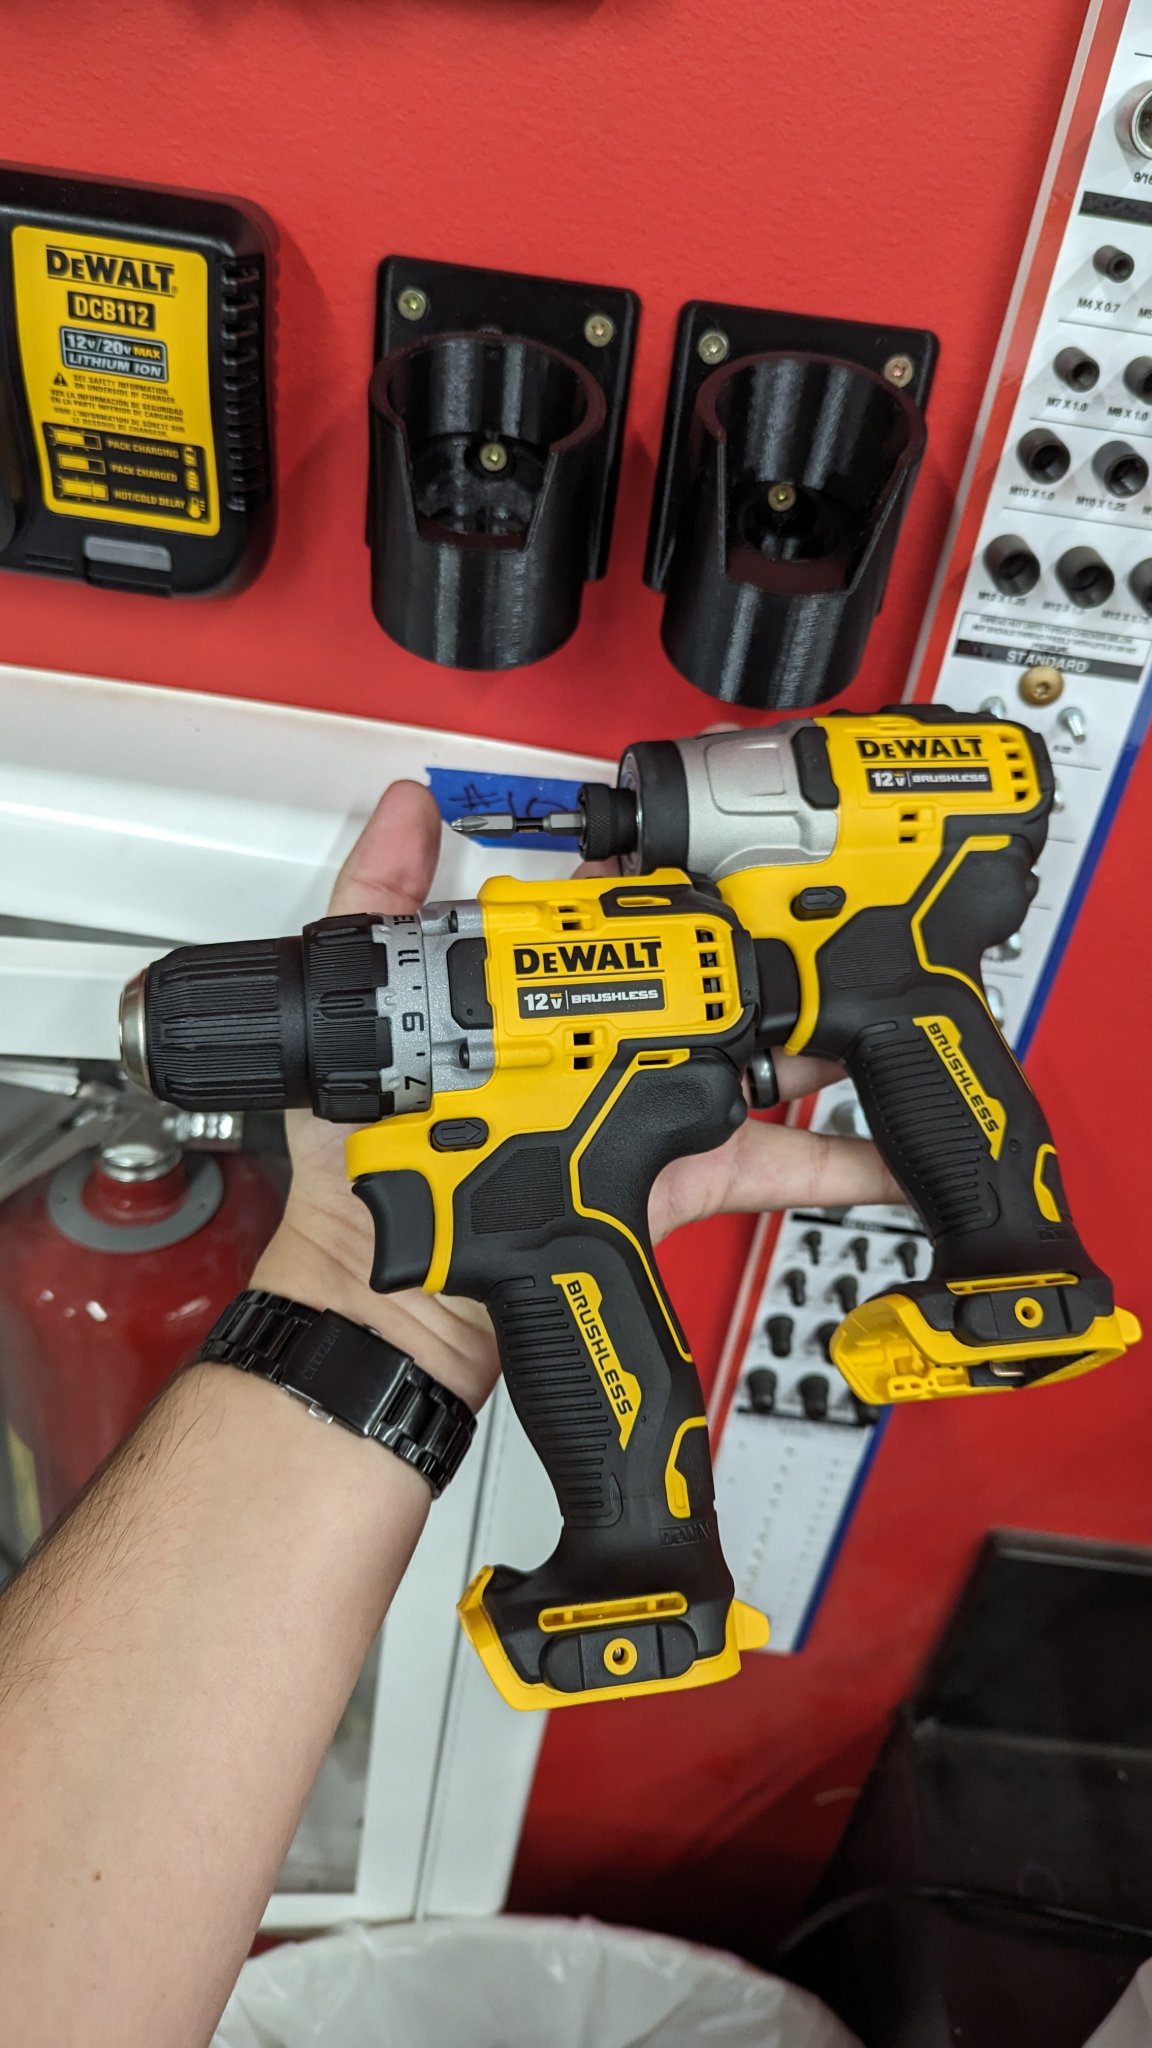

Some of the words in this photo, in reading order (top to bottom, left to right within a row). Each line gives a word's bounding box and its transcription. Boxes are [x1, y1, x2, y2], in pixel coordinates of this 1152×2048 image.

[74, 295, 149, 327] DCB112
[1077, 298, 1093, 309] M4
[1094, 301, 1103, 311] X
[1104, 302, 1121, 314] 0.7
[133, 347, 161, 359] MAX
[69, 353, 130, 372] LITHIUM
[134, 363, 161, 377] ION
[1046, 397, 1062, 407] M7
[1074, 402, 1088, 412] 1.0
[1134, 410, 1149, 421] 1.0
[108, 440, 132, 451] PACK
[133, 444, 179, 459] CHARGING
[111, 464, 135, 476] PACK
[136, 468, 178, 482] CHARGED
[1009, 486, 1029, 497] M10
[159, 497, 186, 509] DELAY
[1006, 650, 1090, 673] STANDARD
[912, 773, 988, 784] BRUSHLESS
[572, 989, 658, 1004] BRUSHLESS
[405, 1075, 426, 1090] 7
[926, 1022, 999, 1133] BRUSHLESS
[302, 1325, 341, 1380] CITIZEN
[567, 1280, 633, 1415] BRUSHLESS
